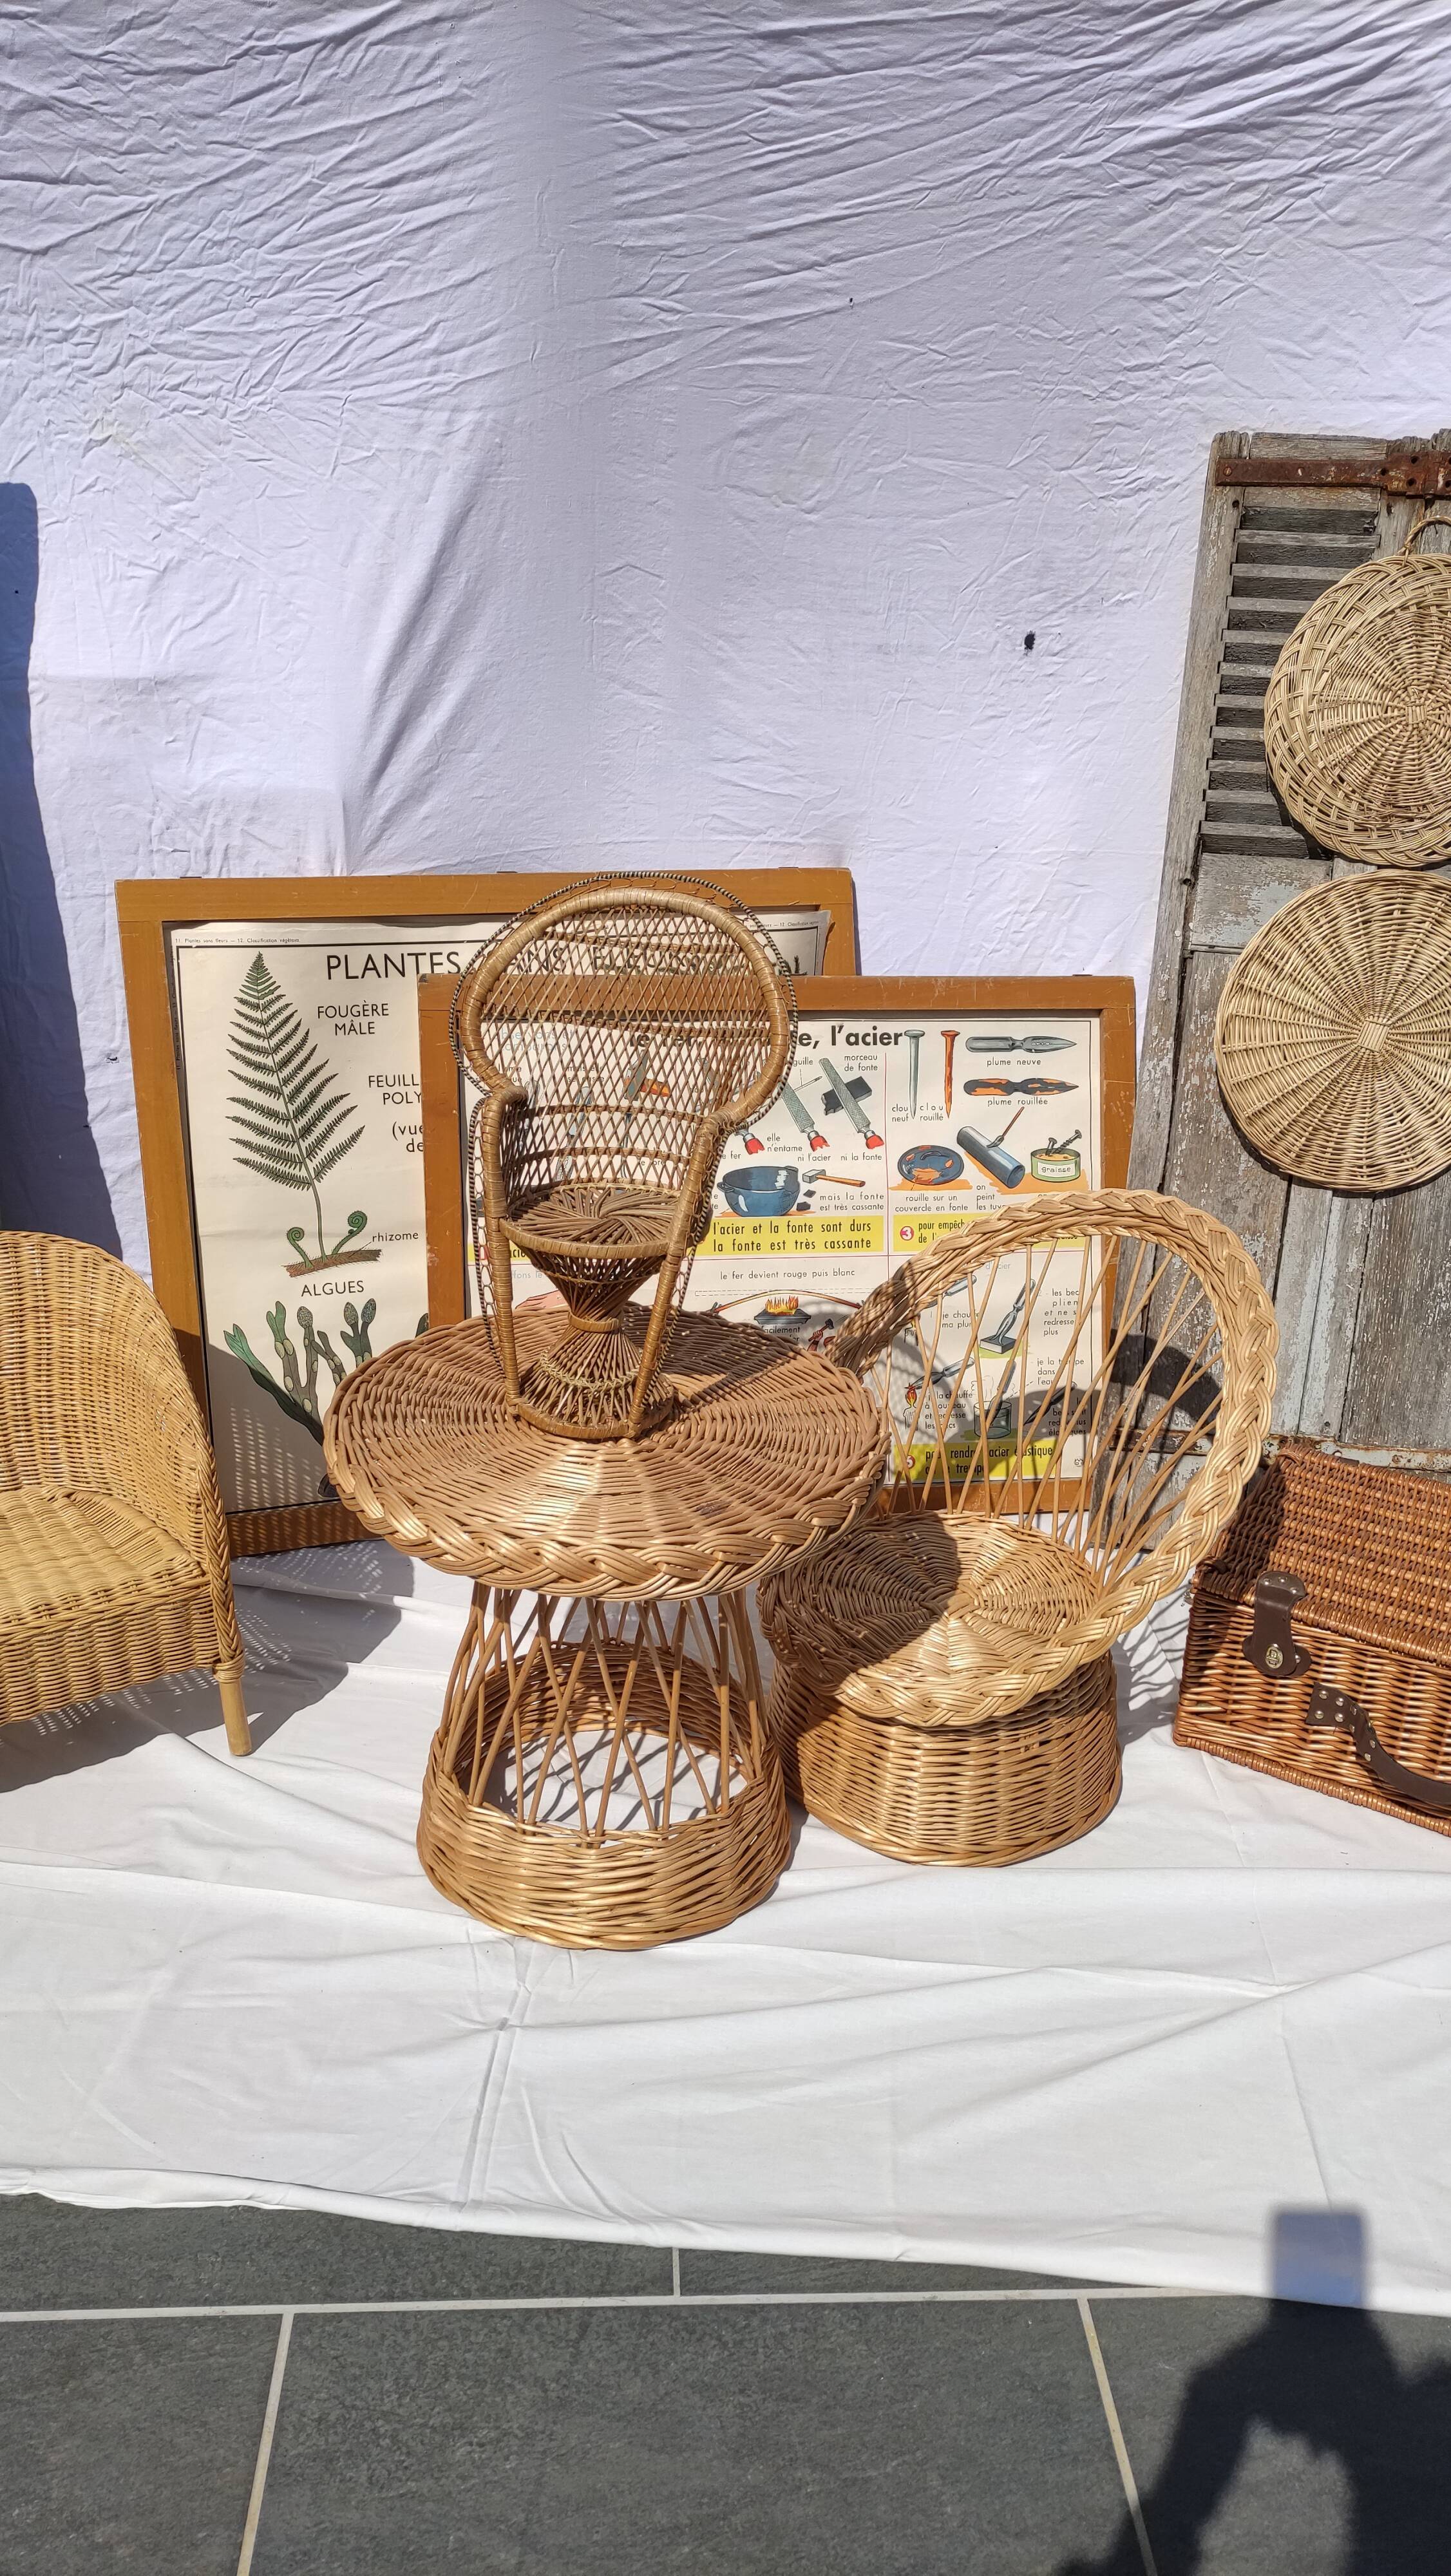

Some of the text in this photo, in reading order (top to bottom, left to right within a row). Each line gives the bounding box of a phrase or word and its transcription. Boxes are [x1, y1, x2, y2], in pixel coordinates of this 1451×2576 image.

[327, 951, 462, 980] PLANTES
[506, 947, 567, 973] ANS
[318, 999, 389, 1019] FOUGÈRE
[334, 1019, 375, 1036] MÂLE
[831, 1025, 903, 1046] l'acier
[793, 1056, 813, 1067] guille
[987, 1057, 1011, 1067] plume
[844, 1063, 878, 1072] de fonte
[368, 1074, 420, 1088] FEUILL
[383, 1091, 422, 1105] POLY
[987, 1097, 1048, 1107] plume rouillée
[891, 1103, 908, 1112] clou
[892, 1114, 909, 1122] neuf
[920, 1112, 944, 1121] rouillé
[766, 1133, 781, 1142] elle
[767, 1144, 802, 1153] n'entame
[730, 1151, 741, 1160] fer
[808, 1153, 831, 1162] l'acier
[851, 1153, 858, 1161] la
[862, 1152, 882, 1161] fonte
[1041, 1165, 1072, 1174] graisse
[819, 1191, 884, 1201] mais la fonte
[906, 1194, 929, 1202] rouille
[976, 1193, 995, 1202] peint
[819, 1201, 884, 1211] est très cassante
[895, 1204, 932, 1212] couvercle
[949, 1203, 969, 1212] fonte
[976, 1199, 987, 1211] les
[713, 1218, 871, 1235] l'acier et la fonte sont durs
[918, 1218, 965, 1232] pour empêch
[372, 1231, 419, 1242] rhizome
[902, 1227, 912, 1240] 3
[918, 1233, 927, 1244] de
[713, 1237, 871, 1252] la fonte est très cassante
[720, 1267, 855, 1280] le fer devient rouge puis blanc
[301, 1280, 365, 1297] ALGUES
[1052, 1287, 1062, 1296] les
[1066, 1287, 1079, 1296] bec
[1052, 1297, 1079, 1308] plien
[1043, 1317, 1076, 1326] redresse
[1043, 1327, 1058, 1337] plus
[1037, 1357, 1043, 1367] je
[1047, 1356, 1054, 1365] la
[1038, 1367, 1056, 1375] dans
[936, 1390, 944, 1399] la
[925, 1421, 935, 1430] les
